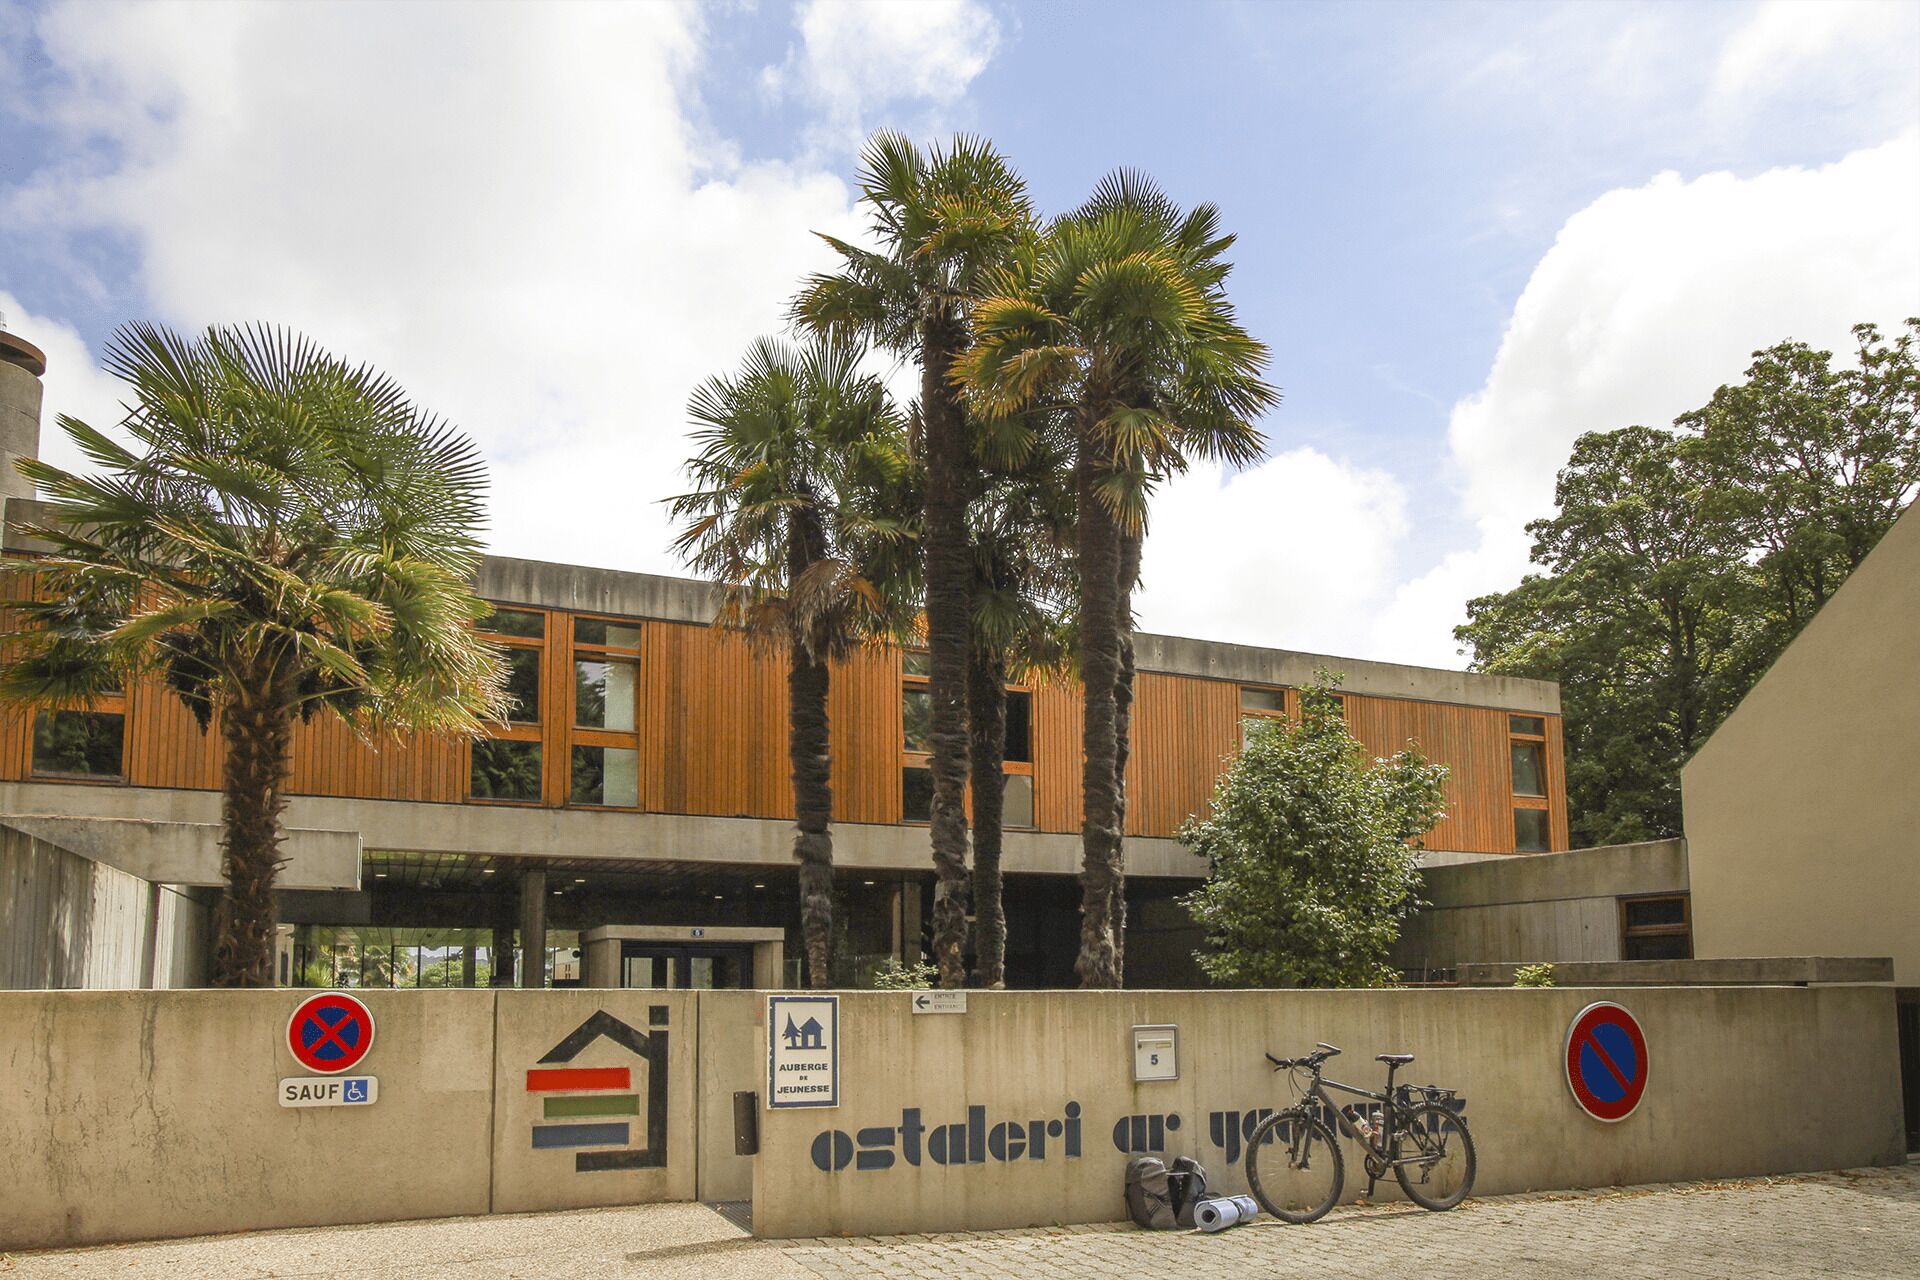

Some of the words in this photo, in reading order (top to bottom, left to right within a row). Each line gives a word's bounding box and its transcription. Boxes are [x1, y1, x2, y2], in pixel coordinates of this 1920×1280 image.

[1150, 1053, 1159, 1066] 5
[778, 1062, 829, 1072] AUBERGE
[285, 1083, 340, 1101] SAUF
[776, 1084, 830, 1094] JEUNESSE
[811, 1100, 1082, 1172] ostaleri
[1112, 1112, 1182, 1154] ar
